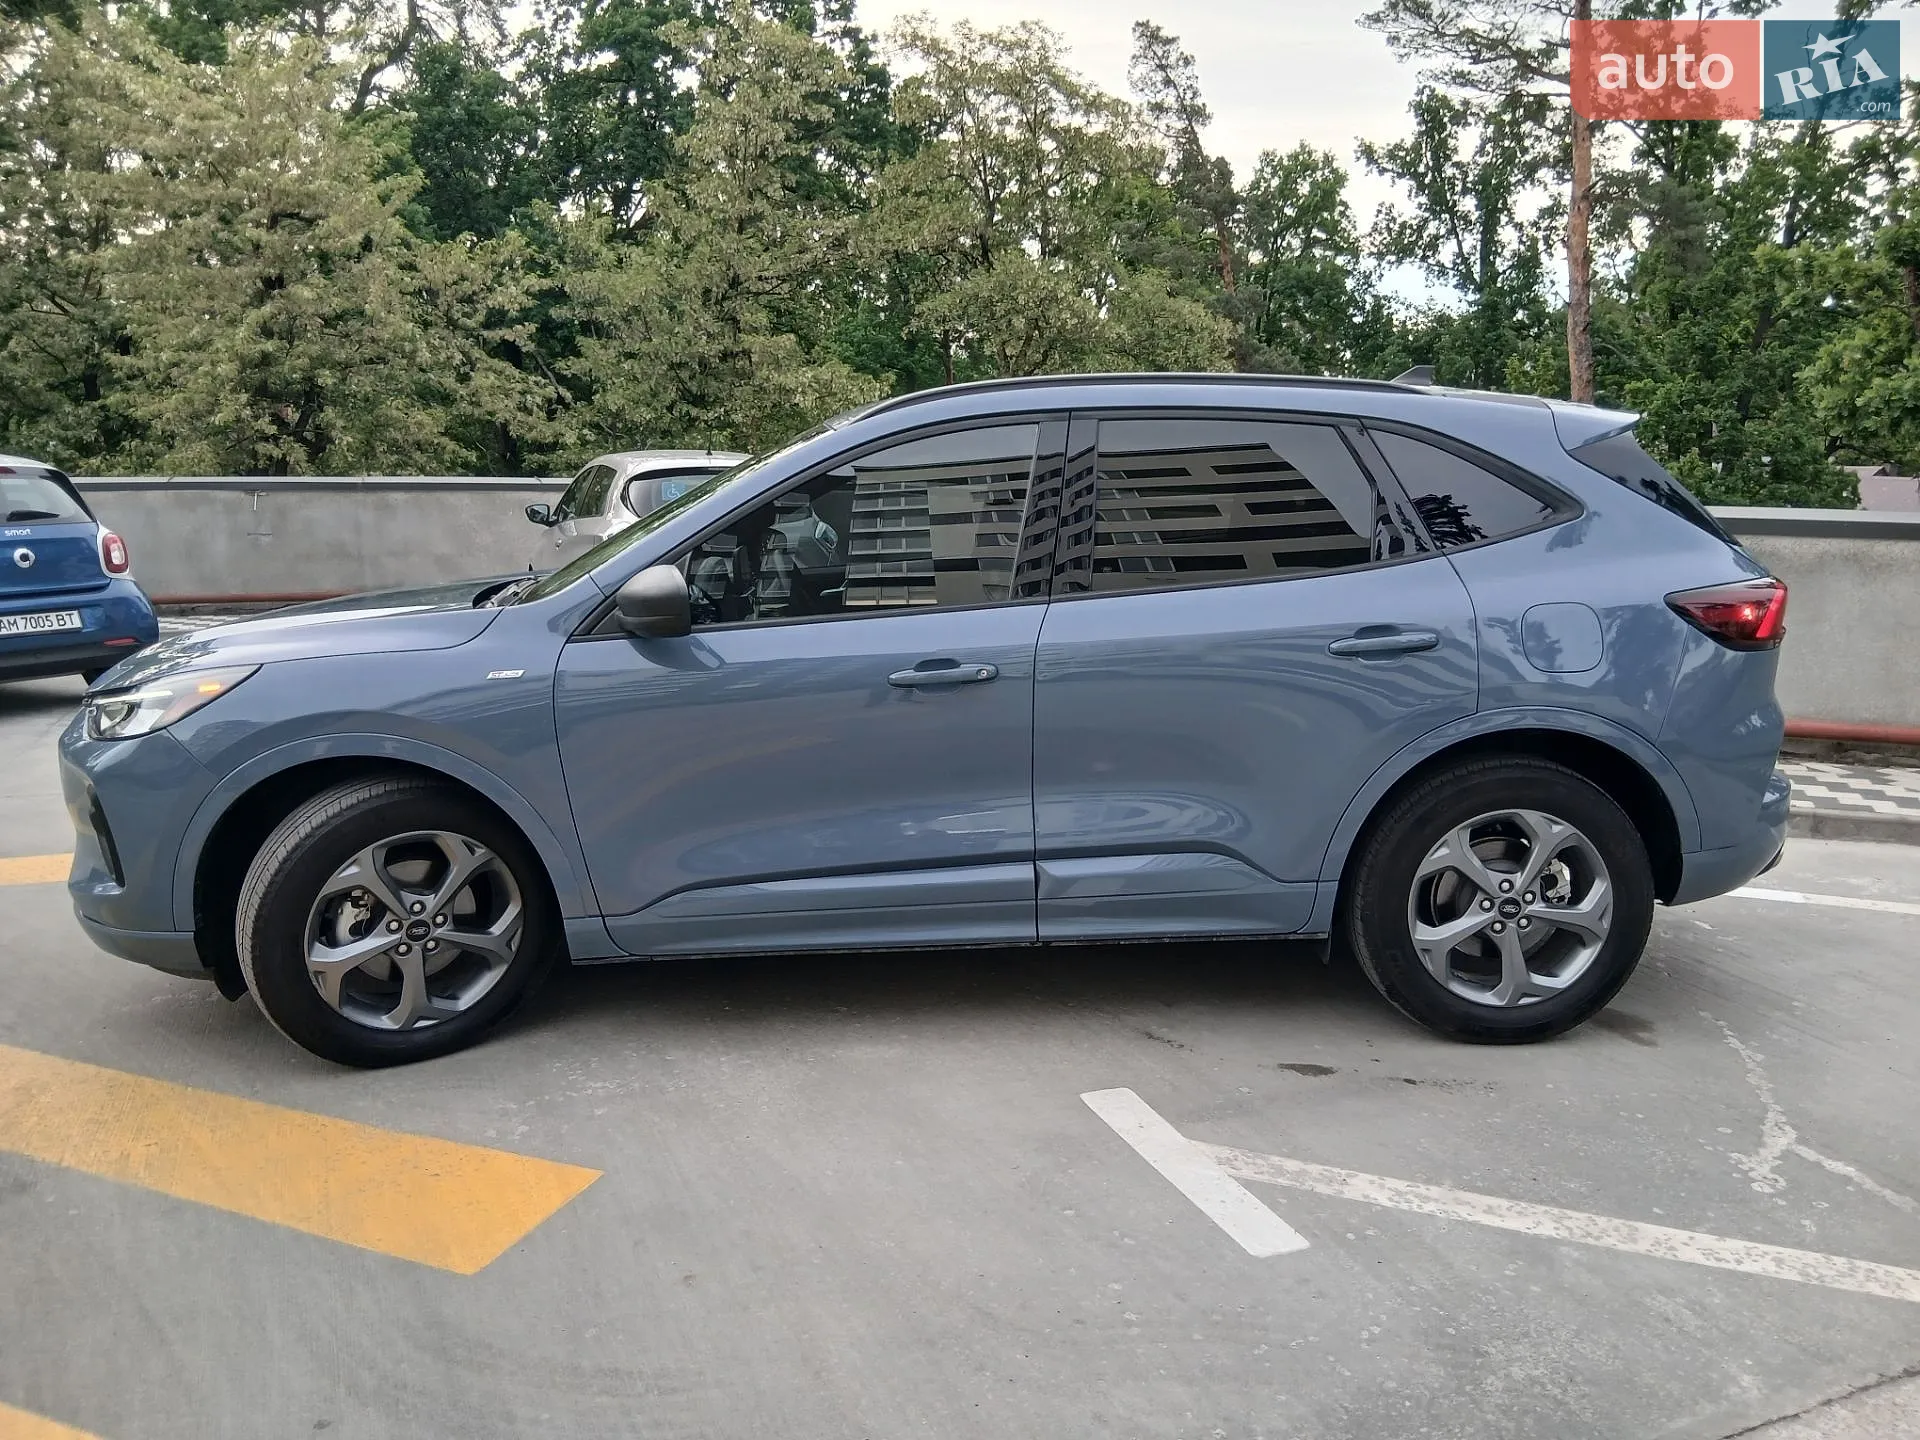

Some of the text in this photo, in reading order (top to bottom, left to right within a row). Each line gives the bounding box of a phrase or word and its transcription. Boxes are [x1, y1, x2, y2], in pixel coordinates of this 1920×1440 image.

[4, 528, 32, 536] smart
[0, 613, 75, 631] AM 7005 BT
